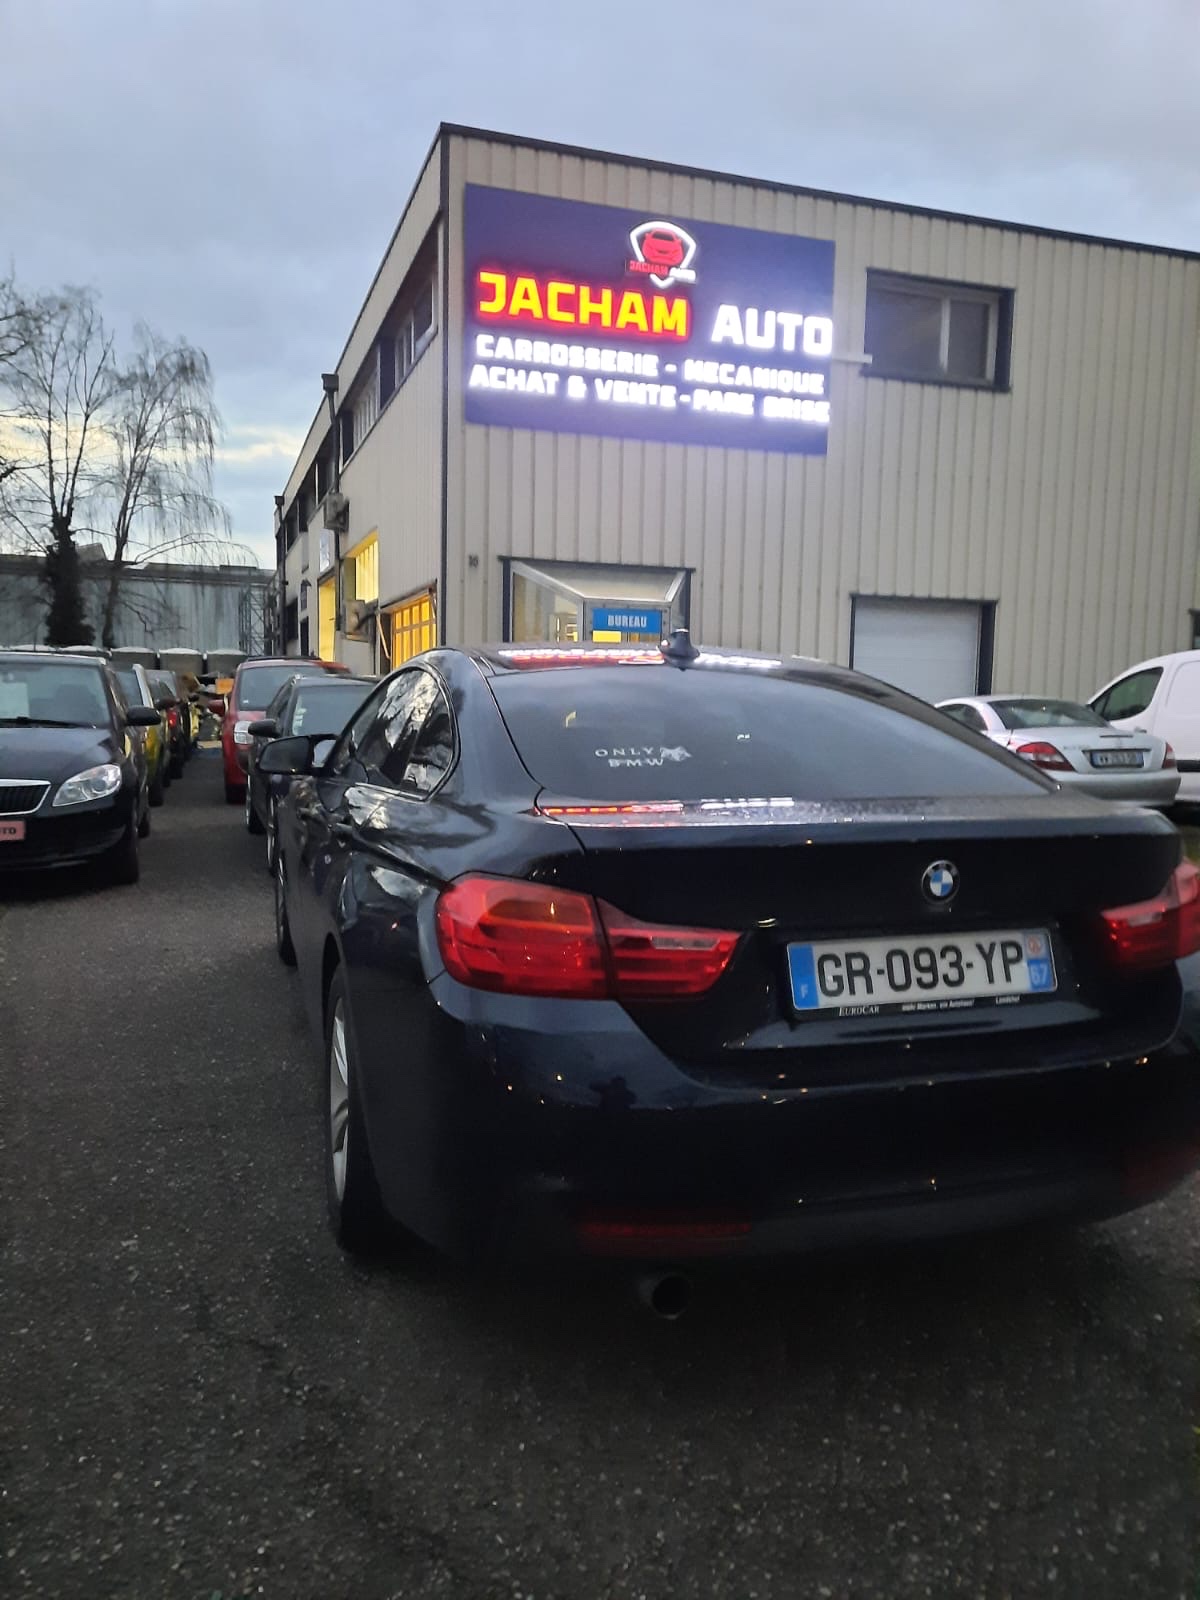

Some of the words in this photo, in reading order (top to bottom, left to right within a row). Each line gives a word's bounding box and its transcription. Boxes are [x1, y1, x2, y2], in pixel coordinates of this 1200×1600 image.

[478, 271, 688, 337] JACHAM
[711, 304, 833, 356] AUTO
[469, 364, 559, 395] ACHAT
[568, 376, 587, 399] &
[595, 378, 676, 408] VENTE
[475, 334, 659, 377] CARROSSERIE
[684, 359, 825, 394] MECANIQUE
[607, 614, 647, 628] BUREAU
[594, 746, 654, 757] ONLY
[608, 758, 664, 768] BMW
[816, 940, 1024, 998] GR-093-YP
[1029, 963, 1048, 986] 67
